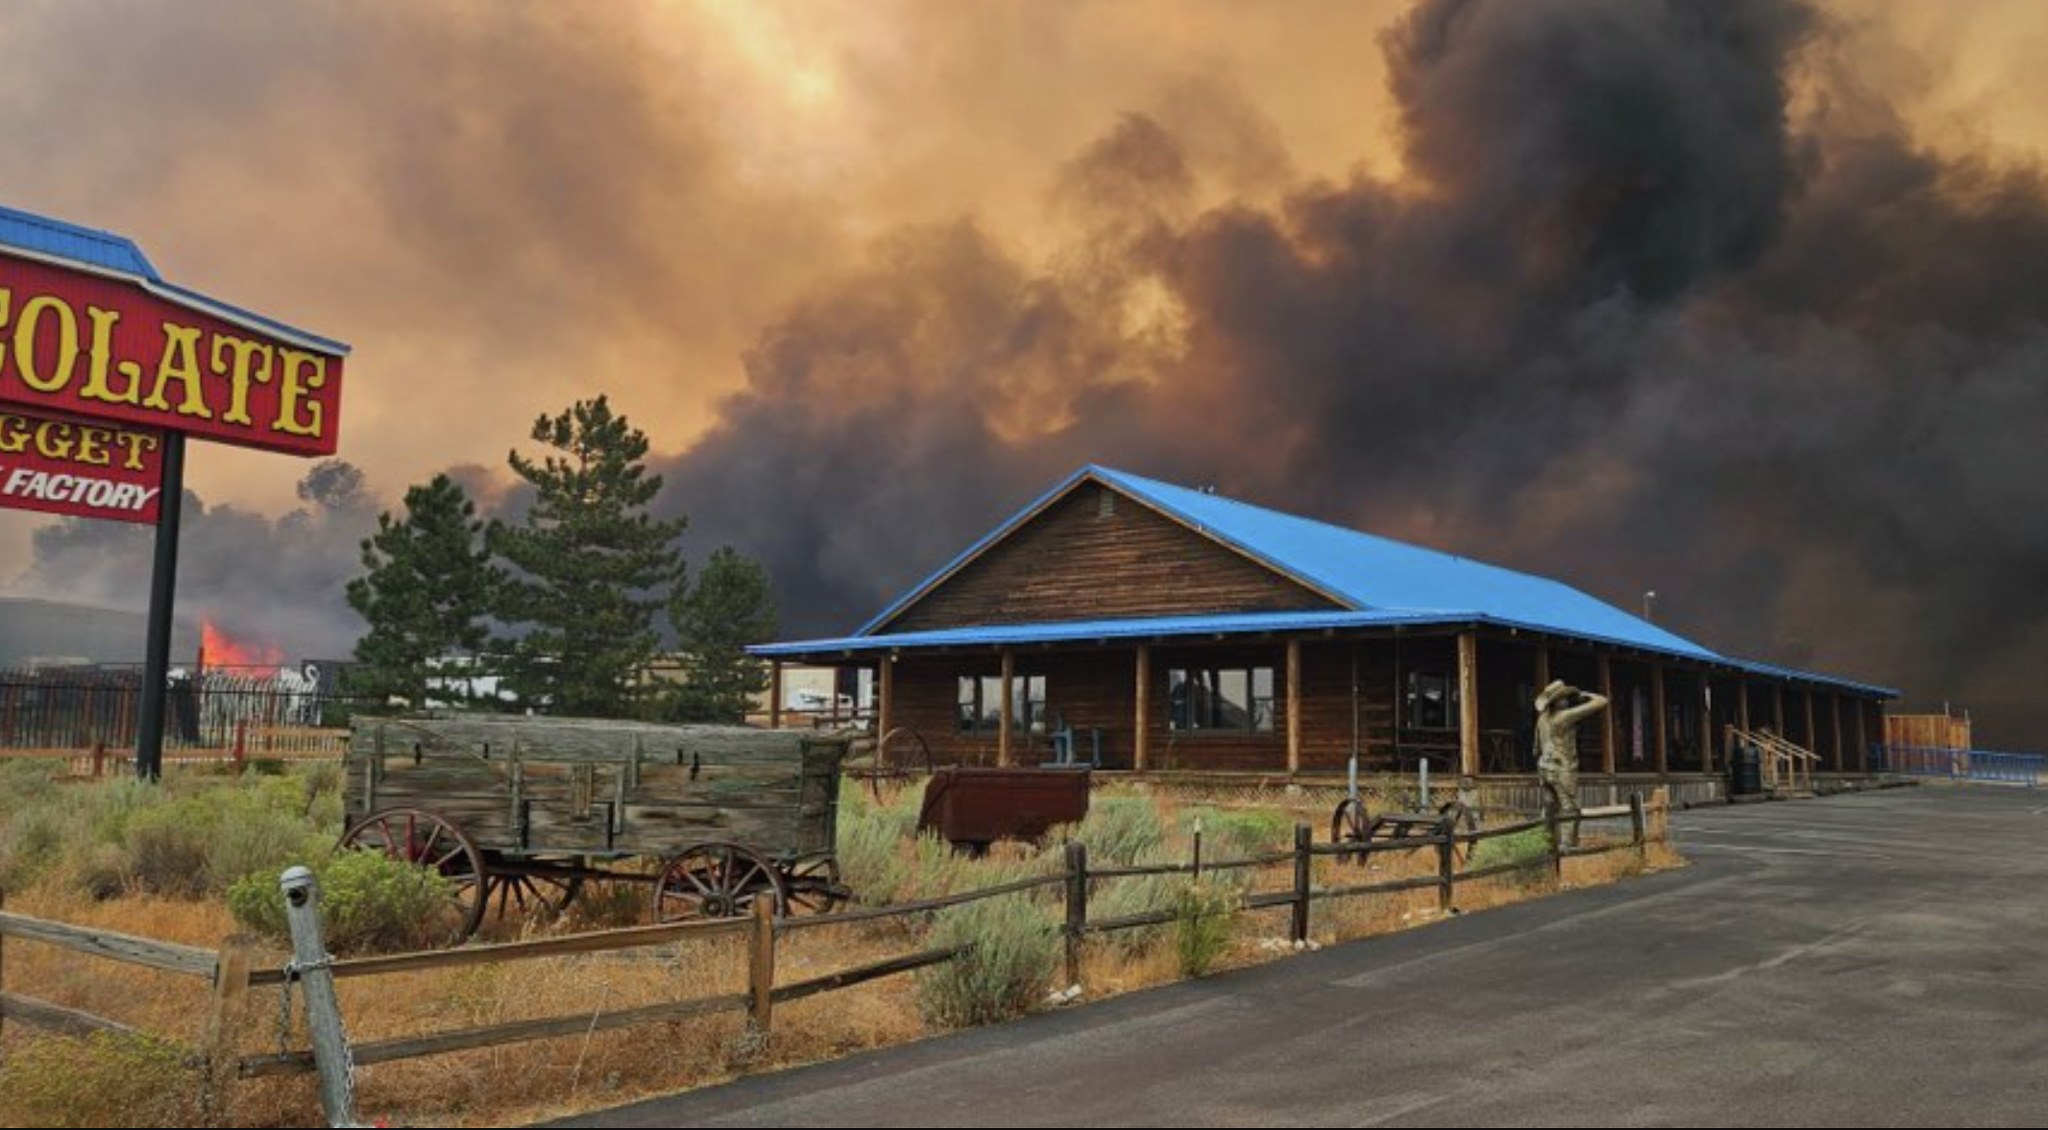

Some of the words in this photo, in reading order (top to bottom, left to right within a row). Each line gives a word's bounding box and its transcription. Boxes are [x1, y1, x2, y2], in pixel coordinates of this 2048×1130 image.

[0, 288, 326, 438] OLATE
[0, 414, 157, 470] GGET
[2, 468, 160, 510] FACTORY
